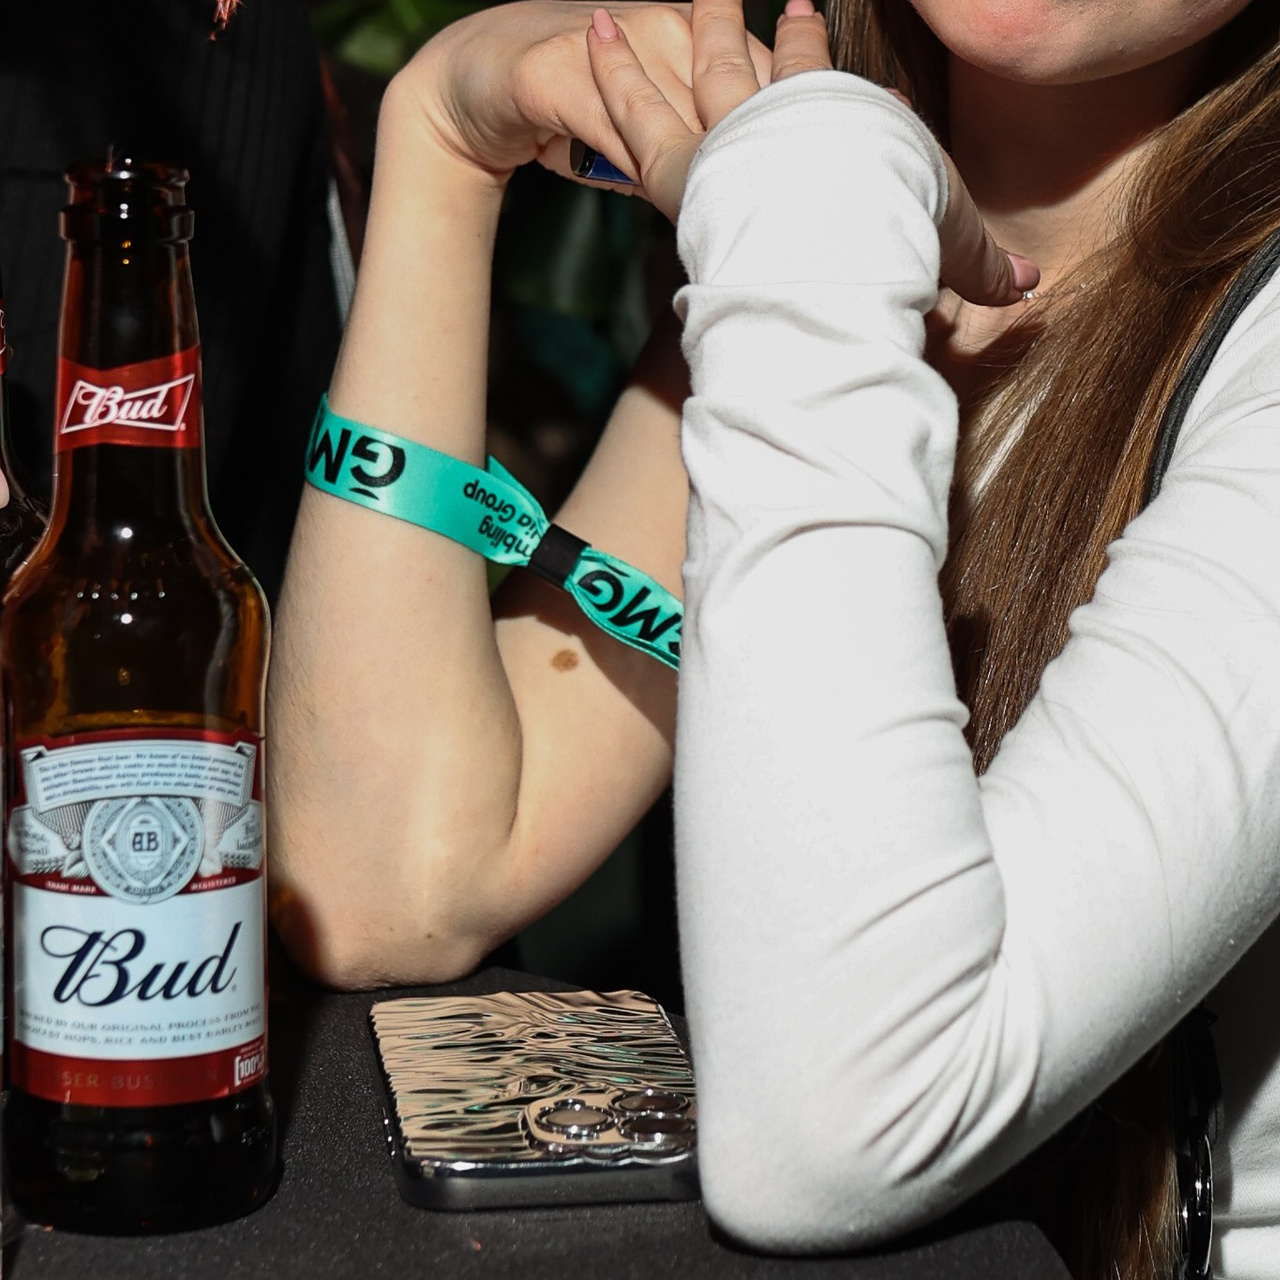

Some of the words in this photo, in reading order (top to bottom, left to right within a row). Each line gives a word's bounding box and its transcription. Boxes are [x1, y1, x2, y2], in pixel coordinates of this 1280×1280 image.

[77, 384, 168, 424] Bud
[308, 427, 406, 500] GM
[463, 479, 516, 523] Group
[478, 515, 532, 558] mbling
[577, 562, 683, 655] MG
[40, 921, 243, 1007] Bud
